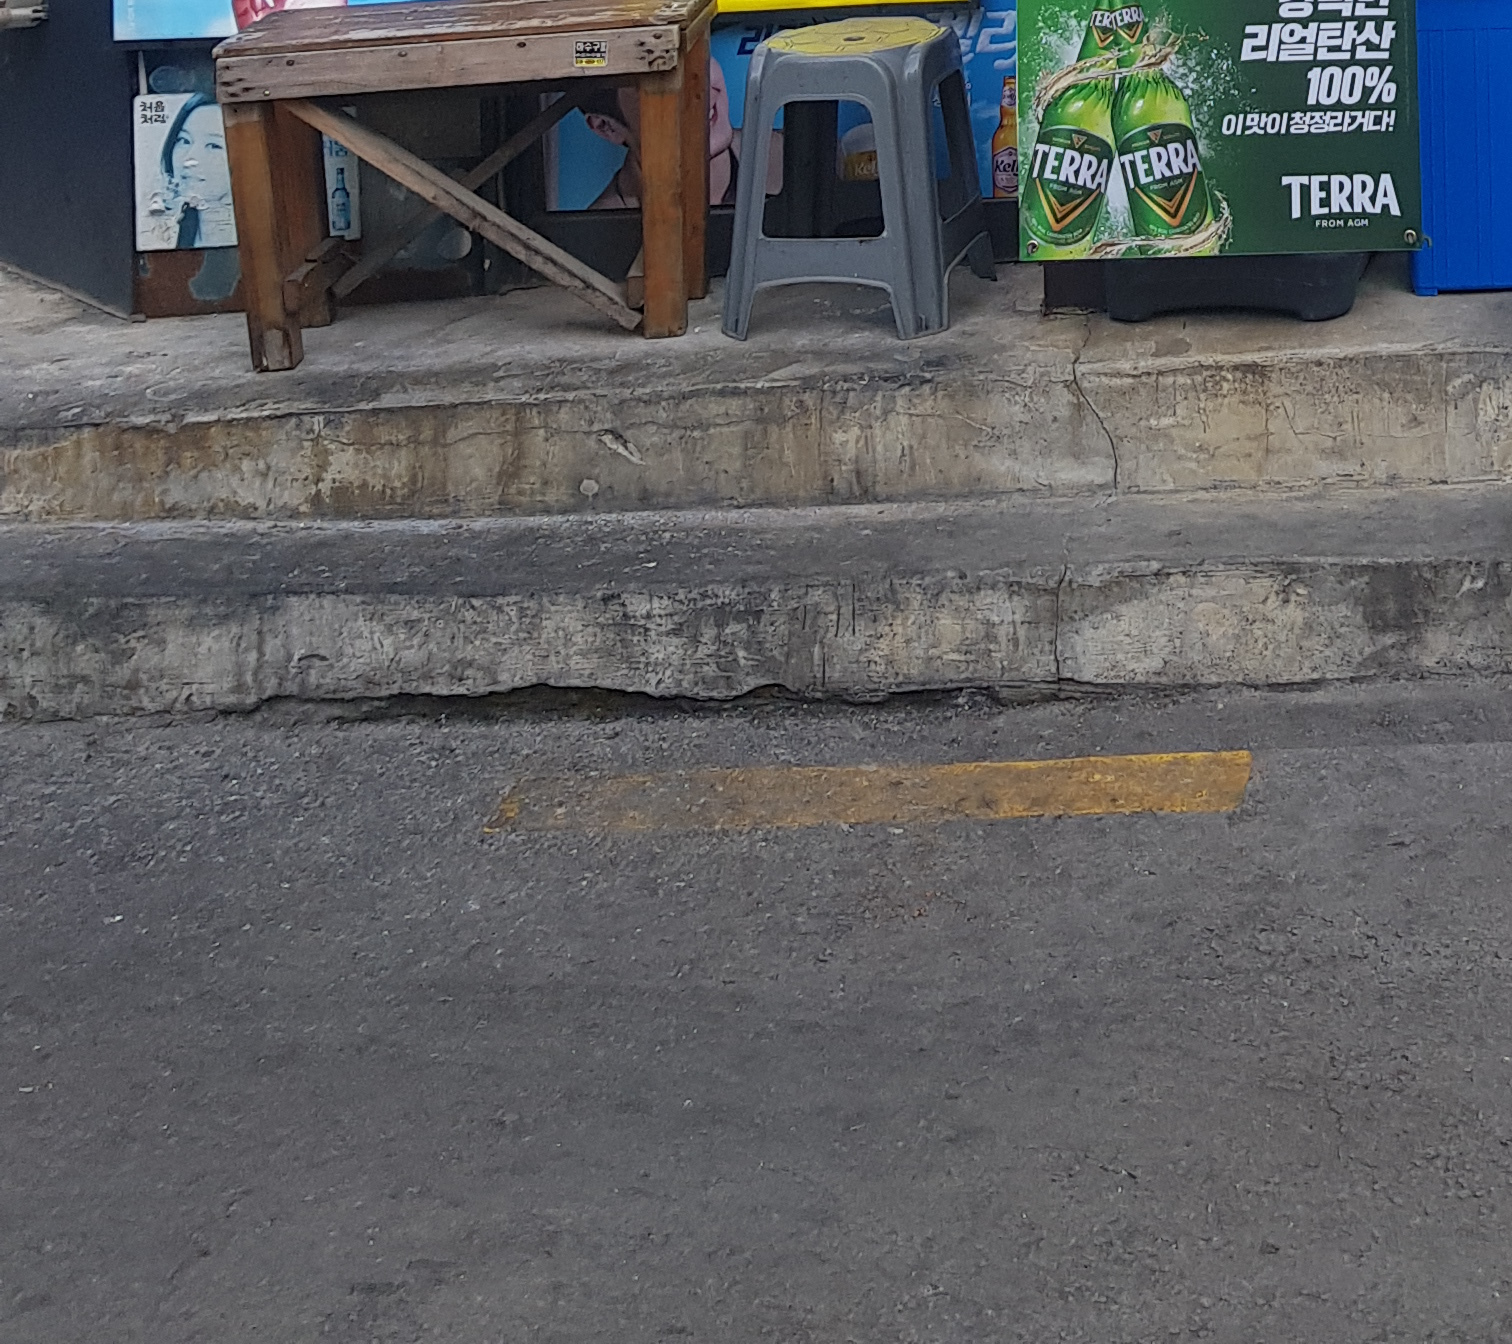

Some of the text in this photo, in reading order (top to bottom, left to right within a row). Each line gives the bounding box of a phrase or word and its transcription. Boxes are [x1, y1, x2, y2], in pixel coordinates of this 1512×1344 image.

[1110, 6, 1145, 30] TERRA
[1240, 20, 1396, 62] 리얼탄산
[1307, 66, 1396, 105] 100%
[140, 101, 164, 113] 처음
[140, 114, 167, 124] 처럼
[1032, 143, 1108, 192] TERRA
[1120, 139, 1202, 189] TERRA
[1281, 173, 1401, 219] TERRA
[1315, 218, 1369, 228] FROM AGM
